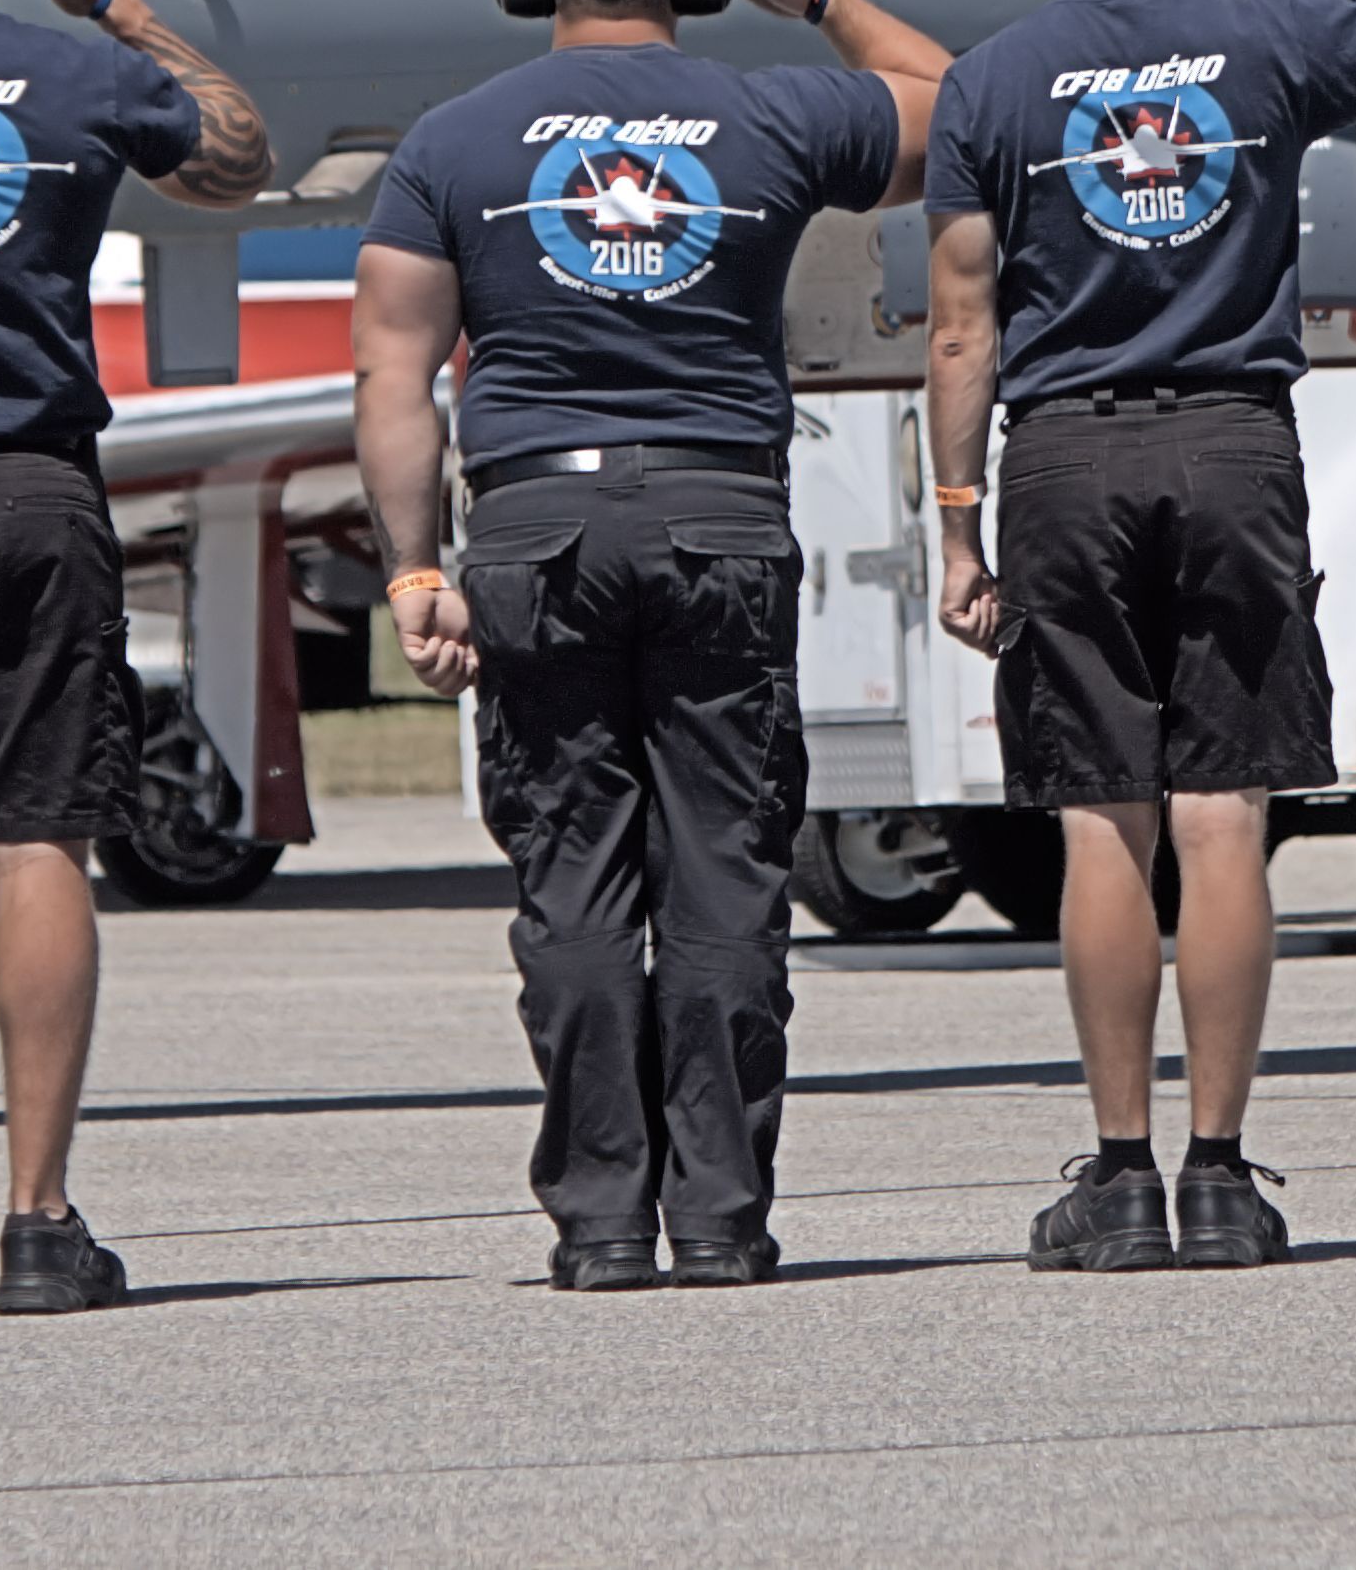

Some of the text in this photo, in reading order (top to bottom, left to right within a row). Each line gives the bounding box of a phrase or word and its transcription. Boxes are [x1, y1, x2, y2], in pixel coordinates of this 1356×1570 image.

[1050, 53, 1227, 99] CF18 DÉMO
[522, 113, 719, 146] CF18 DÉMO
[1122, 186, 1186, 226] 2016
[1169, 226, 1204, 248] Cold
[1200, 198, 1232, 231] Lake
[590, 240, 665, 276] 2016
[643, 283, 684, 302] Cold
[680, 260, 716, 289] Lake
